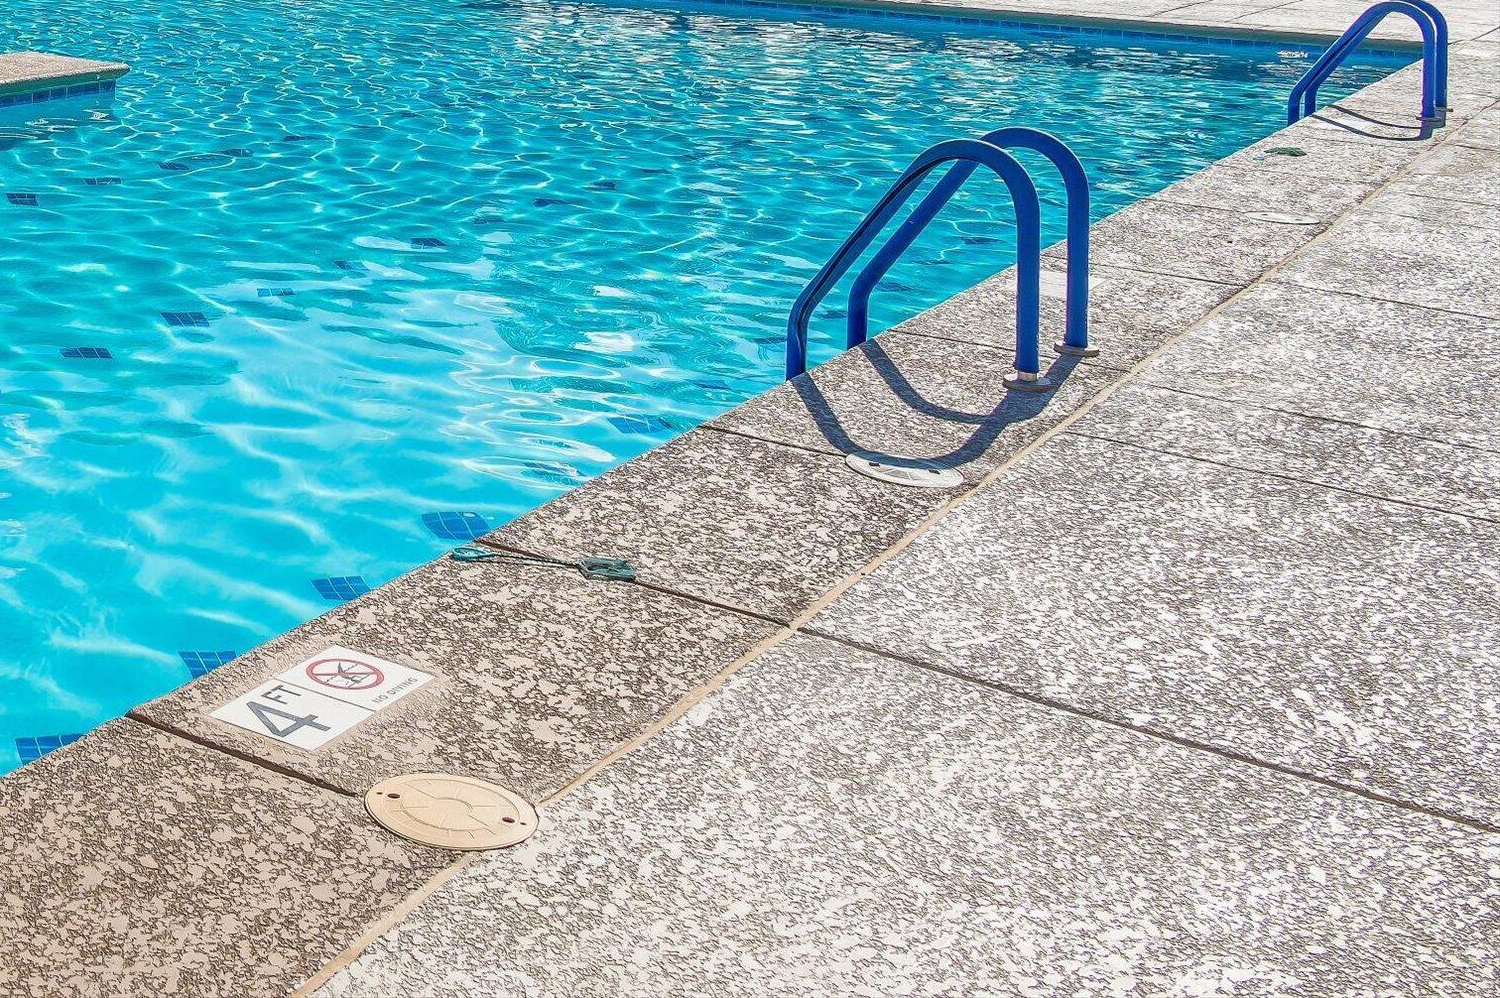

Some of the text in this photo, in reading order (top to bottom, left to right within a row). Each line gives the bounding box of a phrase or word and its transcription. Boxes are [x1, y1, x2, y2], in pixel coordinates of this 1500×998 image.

[372, 677, 419, 704] NO DIVING
[246, 684, 331, 738] 4 FT
